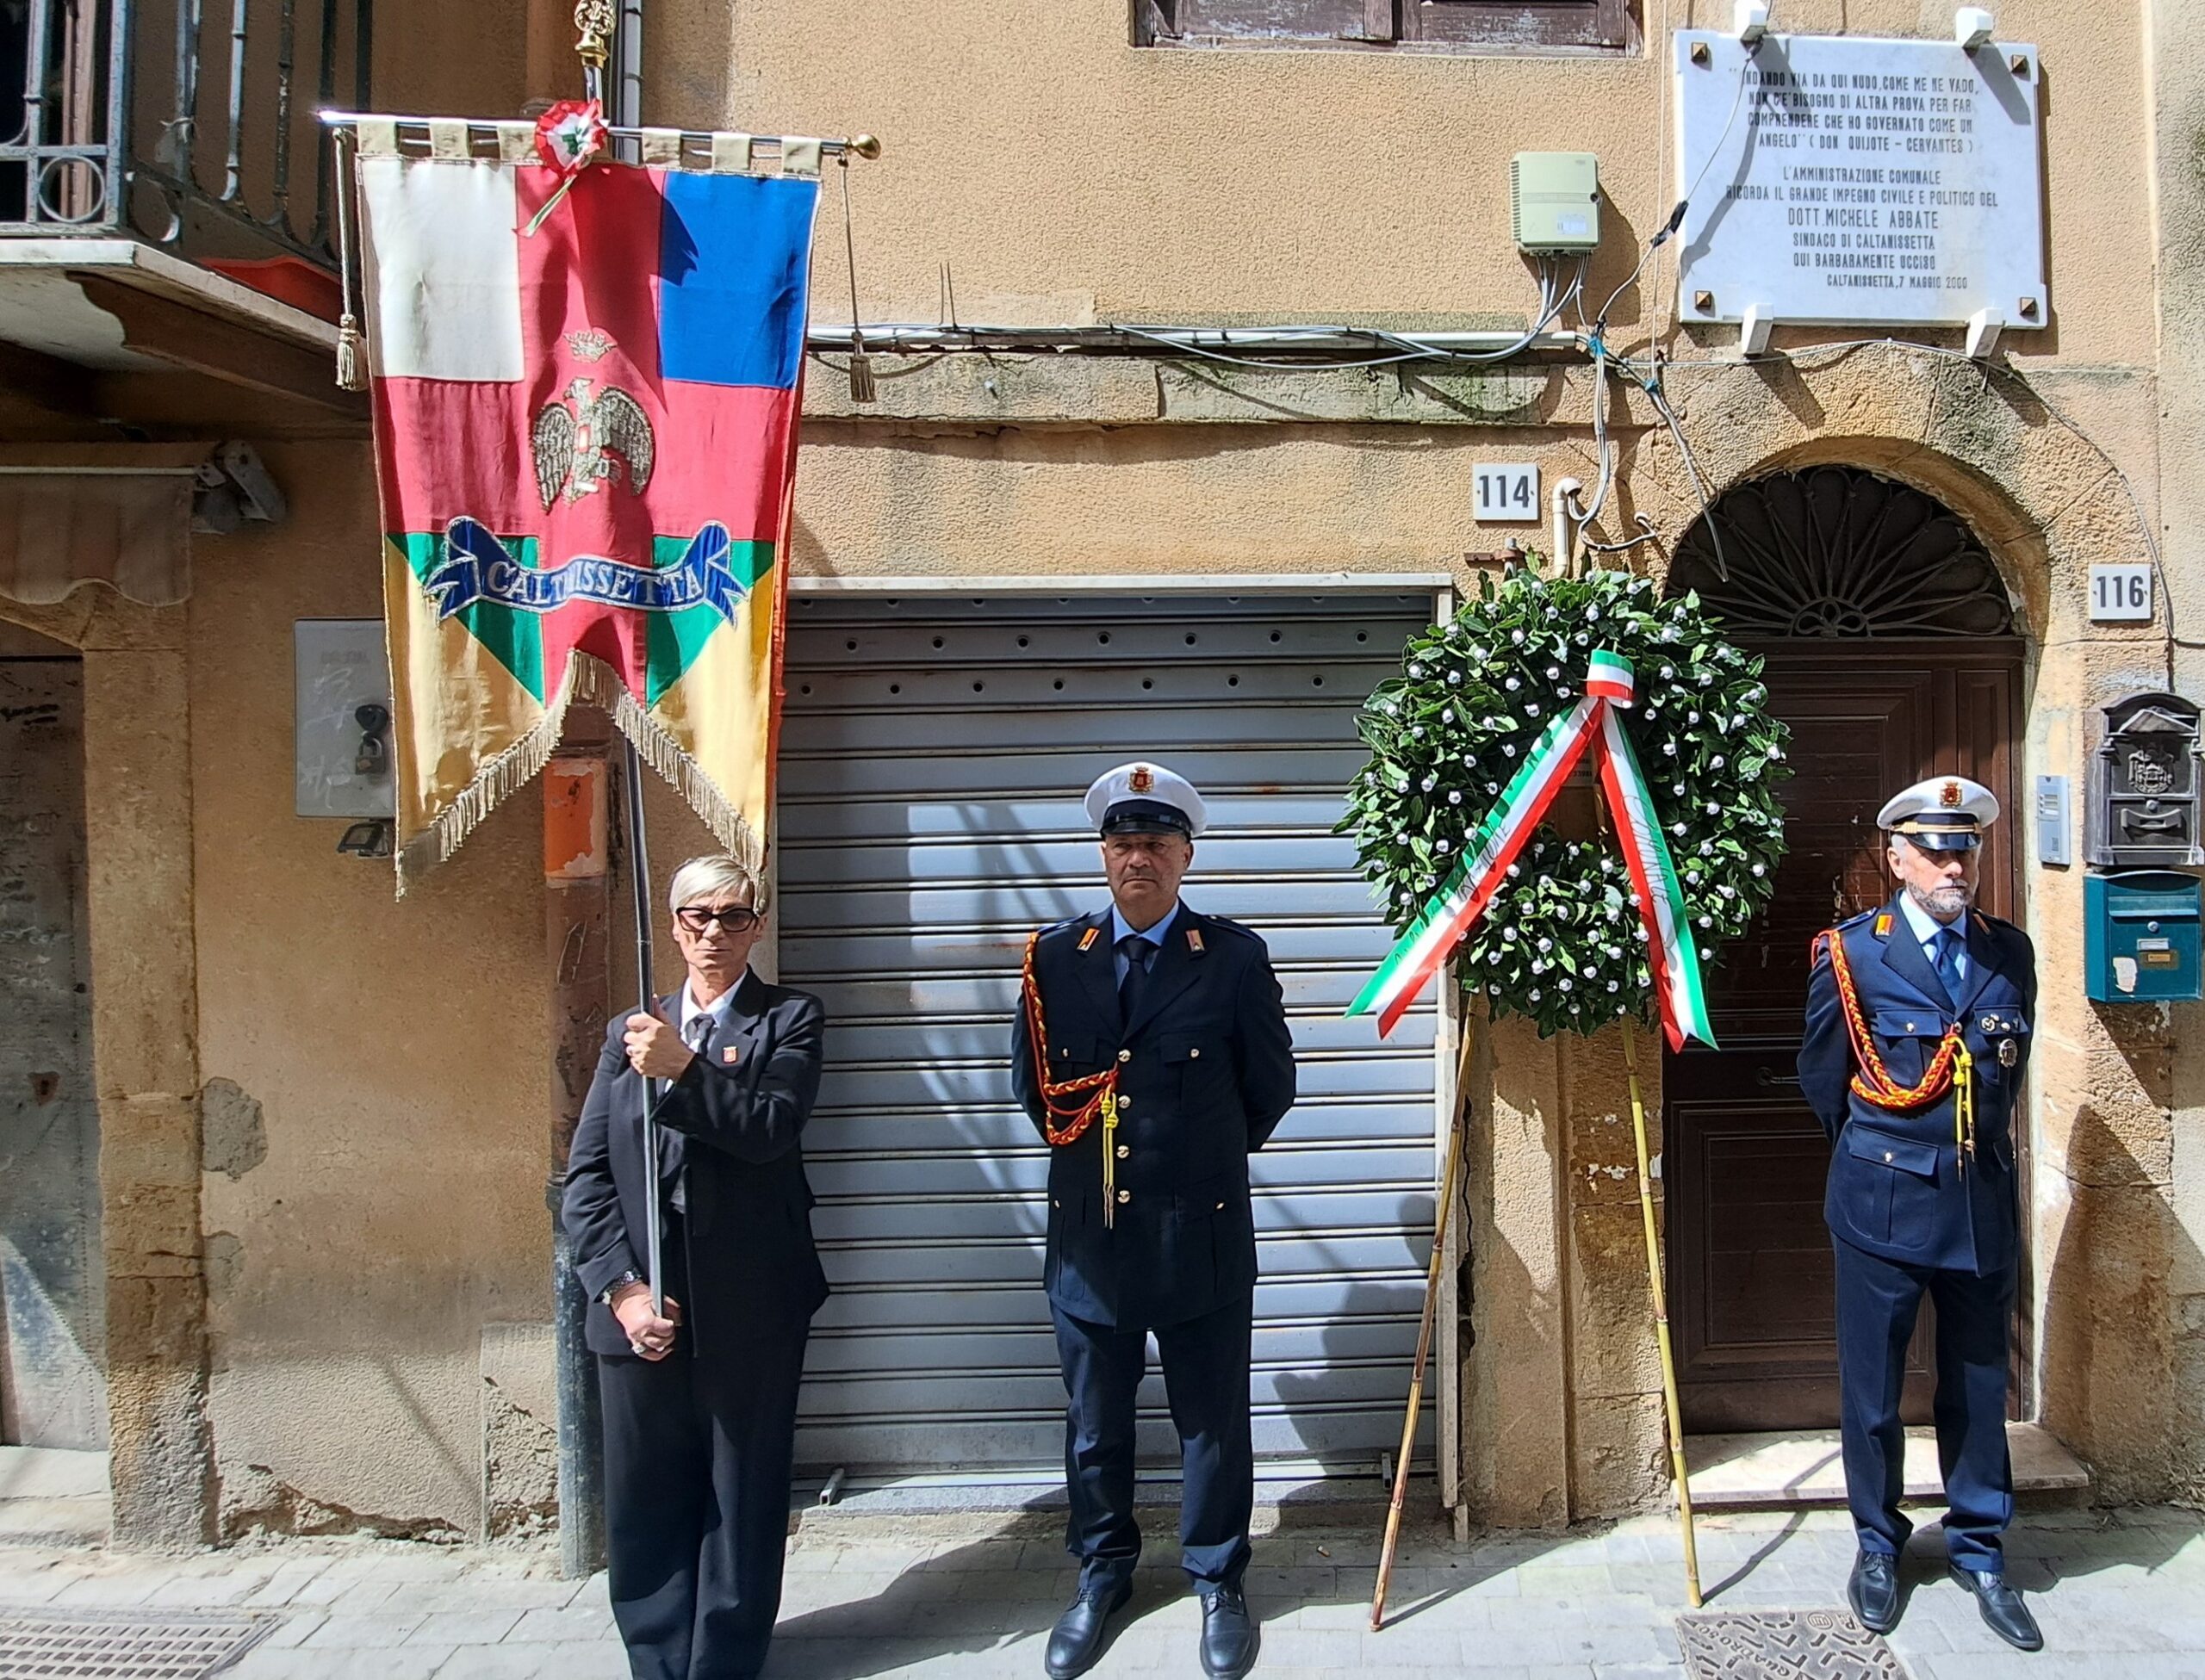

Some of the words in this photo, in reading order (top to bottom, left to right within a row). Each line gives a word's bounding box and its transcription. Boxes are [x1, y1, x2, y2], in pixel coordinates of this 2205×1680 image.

[1790, 72, 1807, 87] VIA
[1813, 73, 1826, 88] DA
[1831, 74, 1848, 89] QUI
[1914, 77, 1927, 91] ME
[1932, 77, 1944, 92] NE
[1948, 78, 1979, 95] VADO,
[1748, 91, 1768, 106] NON
[1841, 95, 1850, 108] DI
[1855, 95, 1888, 110] ALTRA
[1893, 96, 1925, 112] PROVA
[1930, 97, 1948, 112] PER
[1953, 98, 1972, 113] FAR
[1748, 112, 1819, 128] COMPRENDERE
[1824, 115, 1843, 129] CHE
[1848, 115, 1860, 130] HO
[1866, 116, 1923, 132] GOVERNATO
[1929, 118, 1955, 133] COME
[1960, 119, 1972, 133] UN
[1848, 136, 1890, 152] QUIJOTE
[1906, 137, 1963, 153] CERVANTES
[1783, 166, 1885, 183] L'AMMINISTRAZIONE
[1889, 169, 1941, 185] COMUNALE
[1725, 185, 1769, 201] RICORDA
[1775, 186, 1784, 201] IL
[1789, 187, 1829, 201] GRANDE
[1833, 188, 1875, 203] IMPEGNO
[1881, 189, 1914, 204] CIVILE
[1919, 190, 1925, 205] E
[1929, 190, 1975, 207] POLITICO
[1980, 192, 1998, 207] DEL
[1889, 210, 1939, 229] ABBATE
[1792, 232, 1835, 248] SINDACO
[1842, 233, 1851, 248] DI
[1856, 234, 1935, 250] CALTANISSETTA
[1793, 252, 1810, 267] QUI
[1815, 253, 1895, 270] BARBARAMENTE
[1900, 255, 1935, 270] UCCISO
[1910, 276, 1941, 288] MAGGIO
[1946, 276, 1968, 289] 2000
[1479, 474, 1530, 508] 114
[2096, 575, 2144, 608] 116
